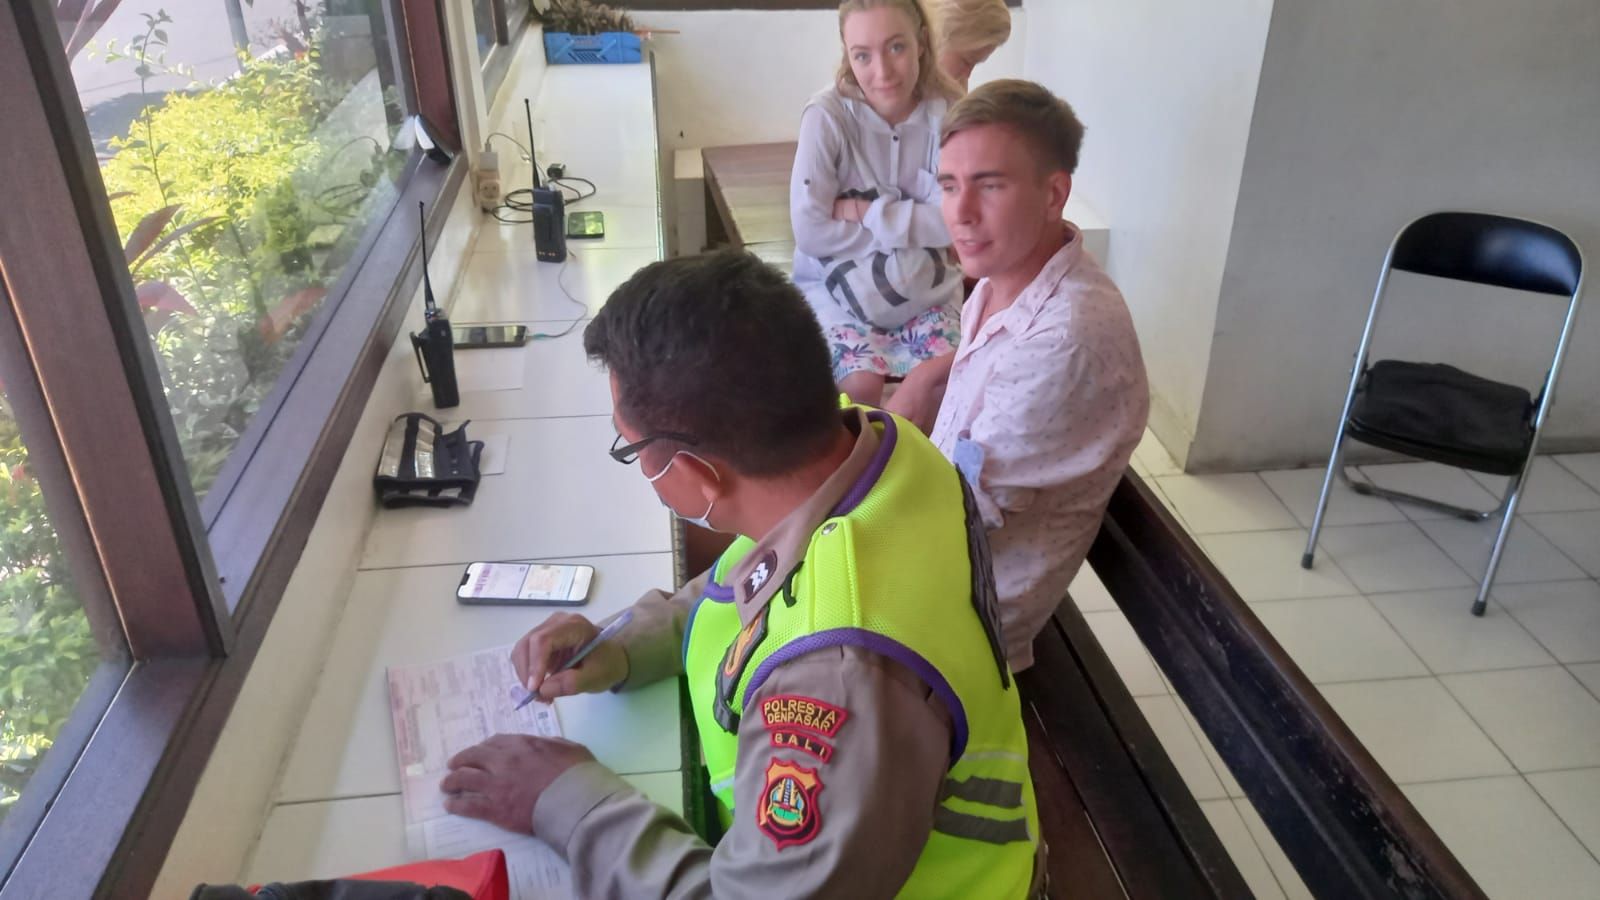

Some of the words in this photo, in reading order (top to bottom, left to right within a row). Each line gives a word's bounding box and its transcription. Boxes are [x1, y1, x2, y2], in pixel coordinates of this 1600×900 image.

[764, 699, 836, 724] POLRESTA
[767, 713, 831, 732] DENPASAR
[774, 733, 825, 756] BALI
